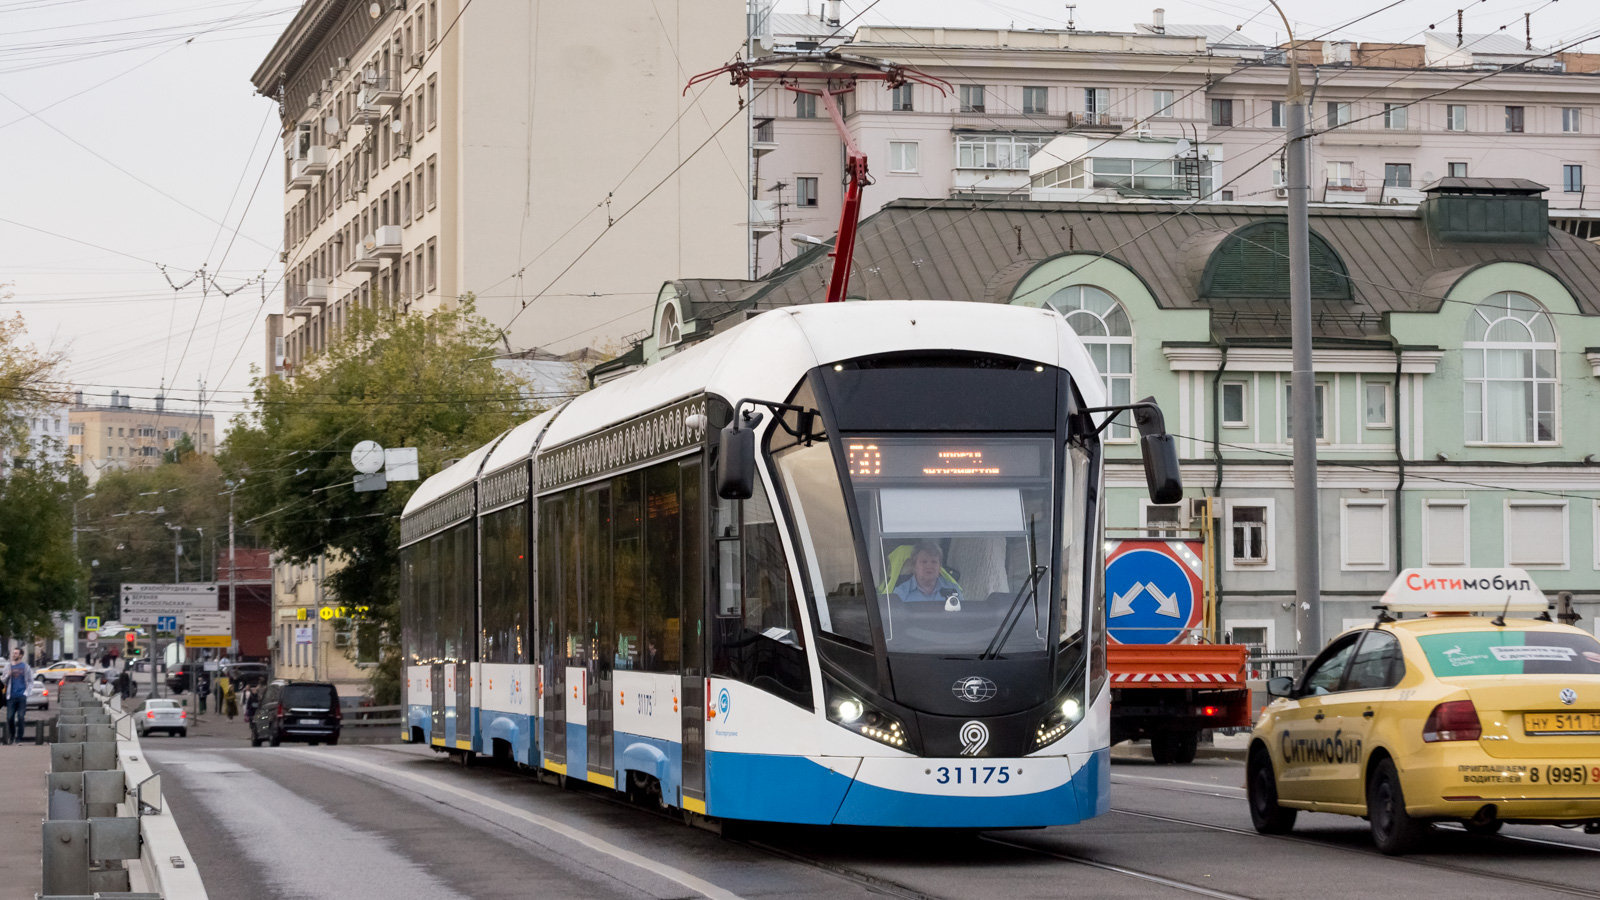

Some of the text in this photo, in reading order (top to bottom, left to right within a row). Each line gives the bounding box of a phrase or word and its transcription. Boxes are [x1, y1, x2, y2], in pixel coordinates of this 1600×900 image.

[1406, 573, 1531, 591] Ситимобил
[1556, 714, 1582, 729] 511
[1281, 728, 1362, 764] Ситимобил
[936, 766, 1010, 784] 31175
[1458, 765, 1527, 773] ПРИГЛАШАЕМ
[1530, 767, 1540, 783] 8
[1546, 765, 1588, 785] (995)
[1463, 774, 1522, 784] ВОДИТЕЛЕЙ
